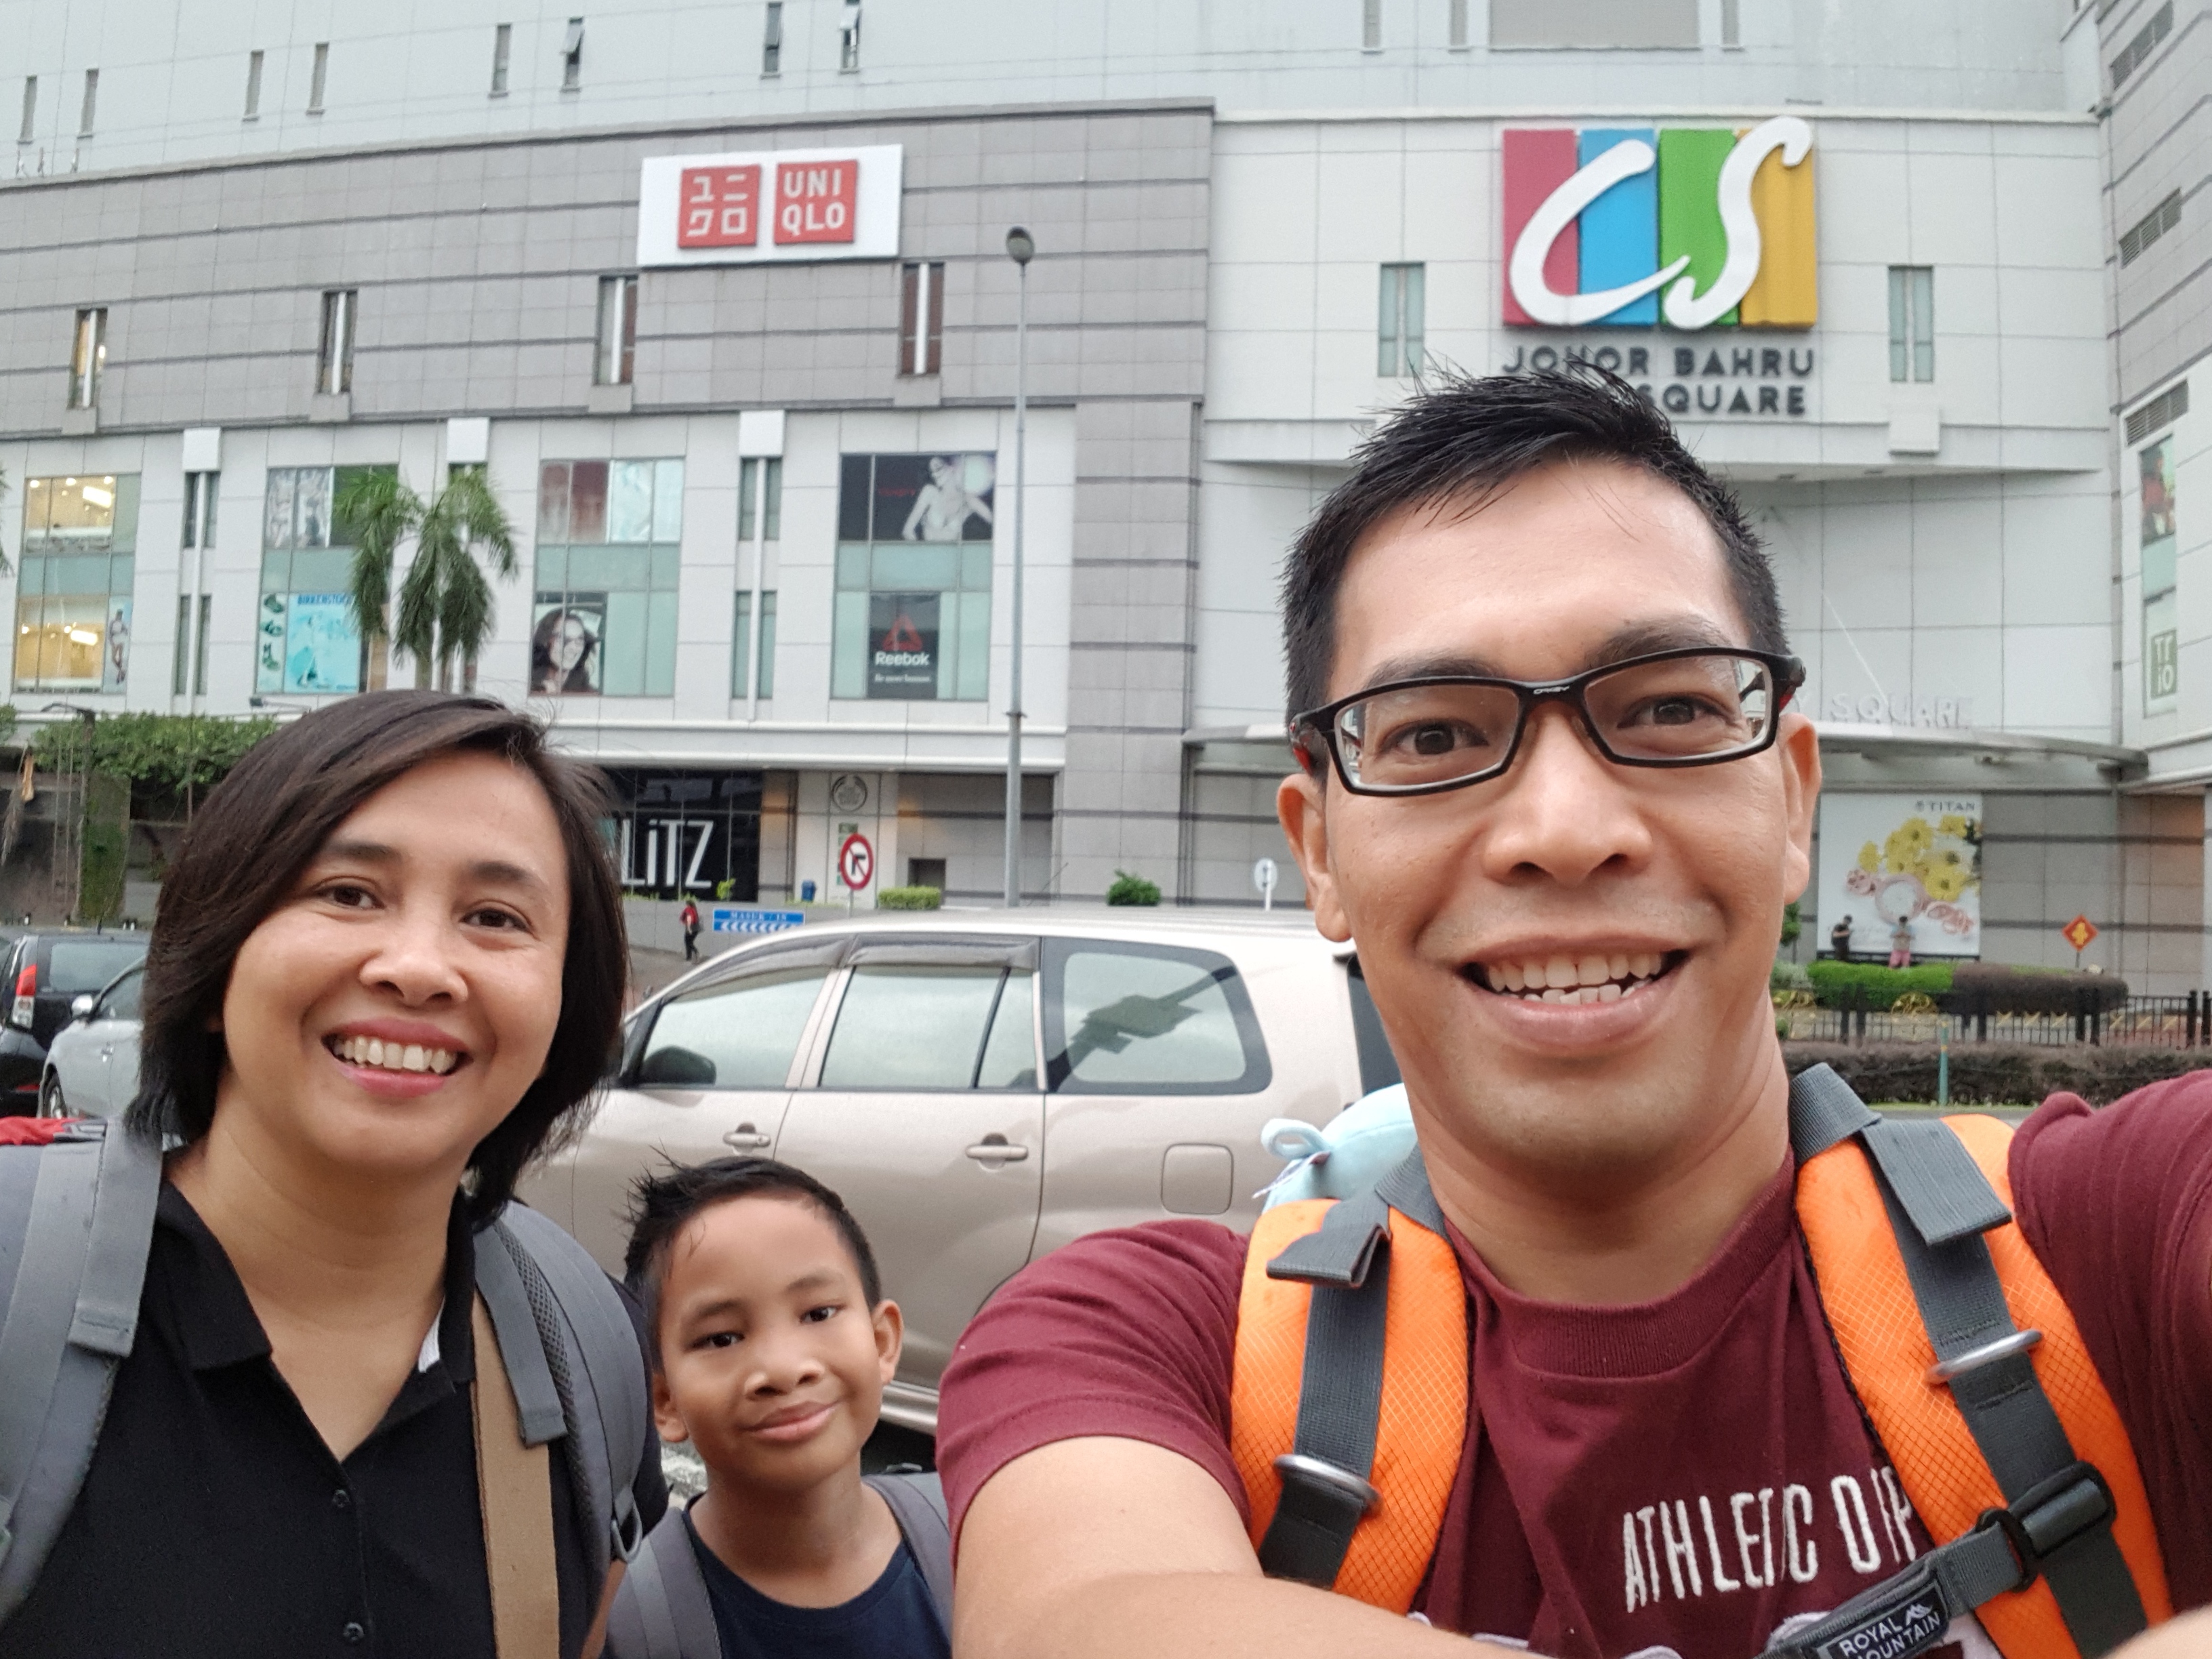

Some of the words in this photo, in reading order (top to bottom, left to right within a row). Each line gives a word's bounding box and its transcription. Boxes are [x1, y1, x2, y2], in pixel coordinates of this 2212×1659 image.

[783, 168, 842, 199] UNI
[781, 201, 846, 236] QLO
[1502, 344, 1650, 376] JOHOR
[1673, 346, 1814, 377] BAHRU
[875, 651, 930, 666] Reebok
[1930, 801, 1975, 811] TITAN
[1622, 1483, 1819, 1614] ATHLETC
[1839, 1616, 1904, 1658] ROYAL
[1857, 1611, 1942, 1659] OUNTAIN
